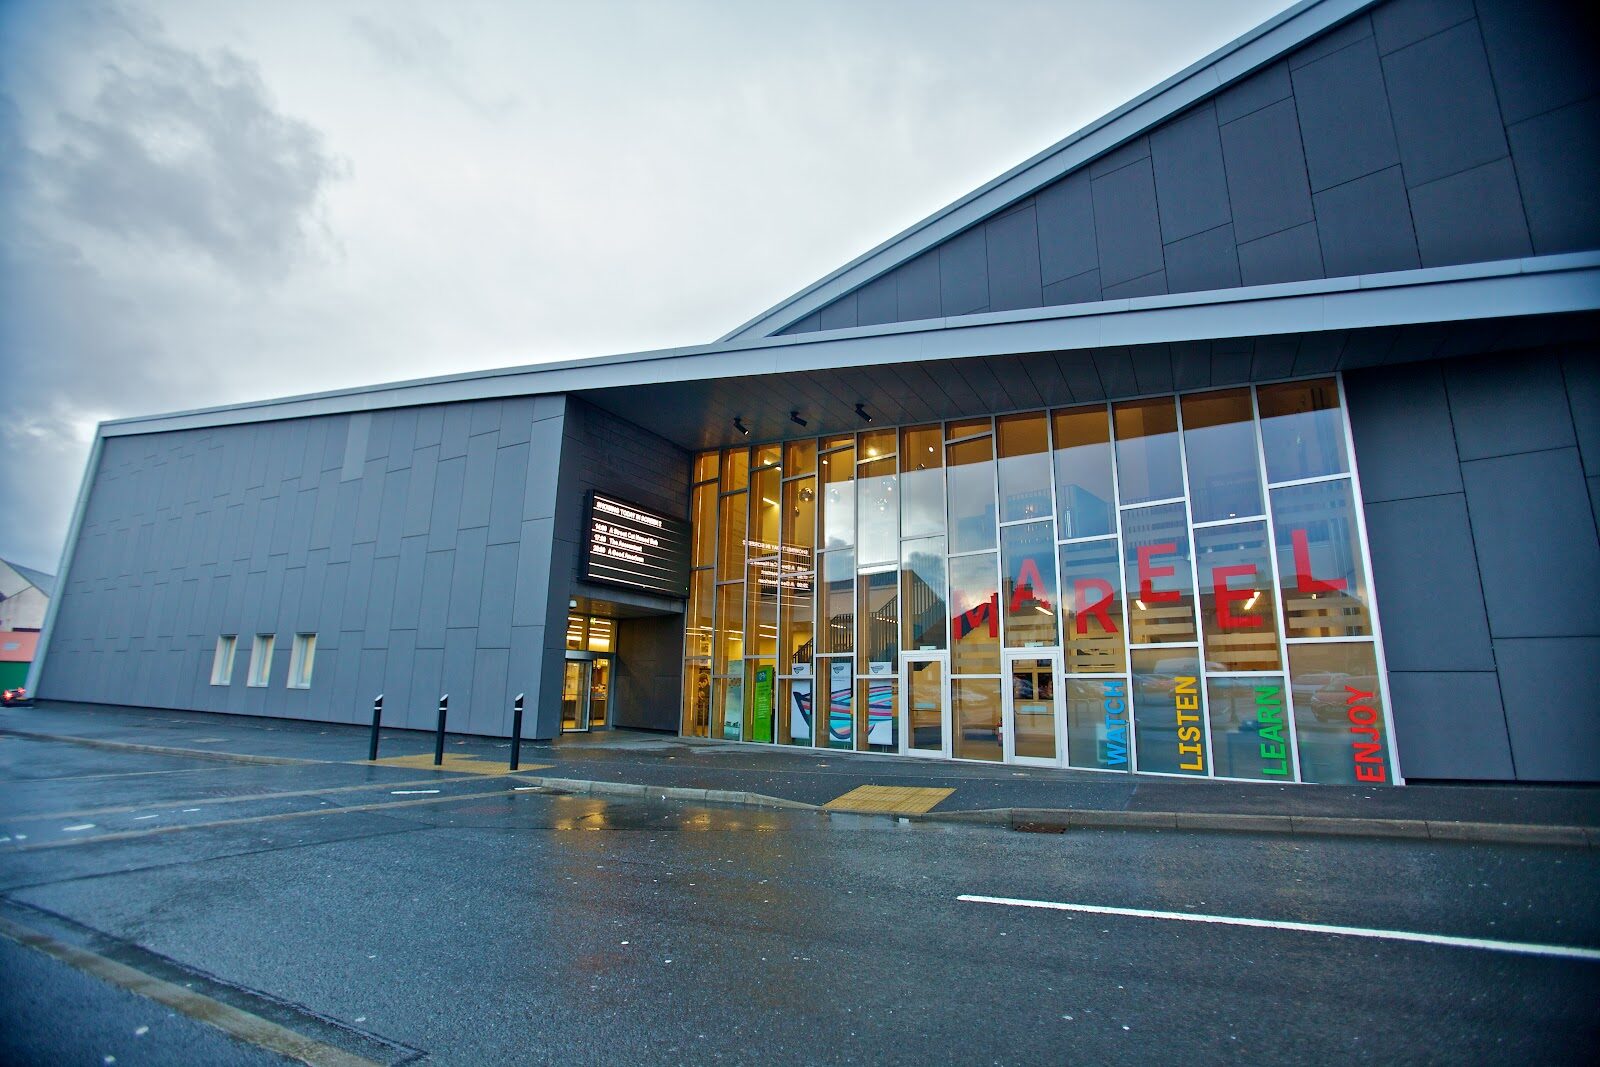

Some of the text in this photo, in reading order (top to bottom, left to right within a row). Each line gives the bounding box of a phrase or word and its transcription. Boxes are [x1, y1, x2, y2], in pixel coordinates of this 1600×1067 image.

[607, 547, 613, 556] A
[609, 526, 614, 535] A
[628, 531, 636, 539] Cat
[609, 537, 619, 546] The
[953, 529, 1347, 640] MAREEL
[1104, 680, 1127, 765] WATCH
[1175, 676, 1203, 771] LISTEN
[1255, 684, 1288, 776] LEARN
[1345, 685, 1386, 782] ENJOY
